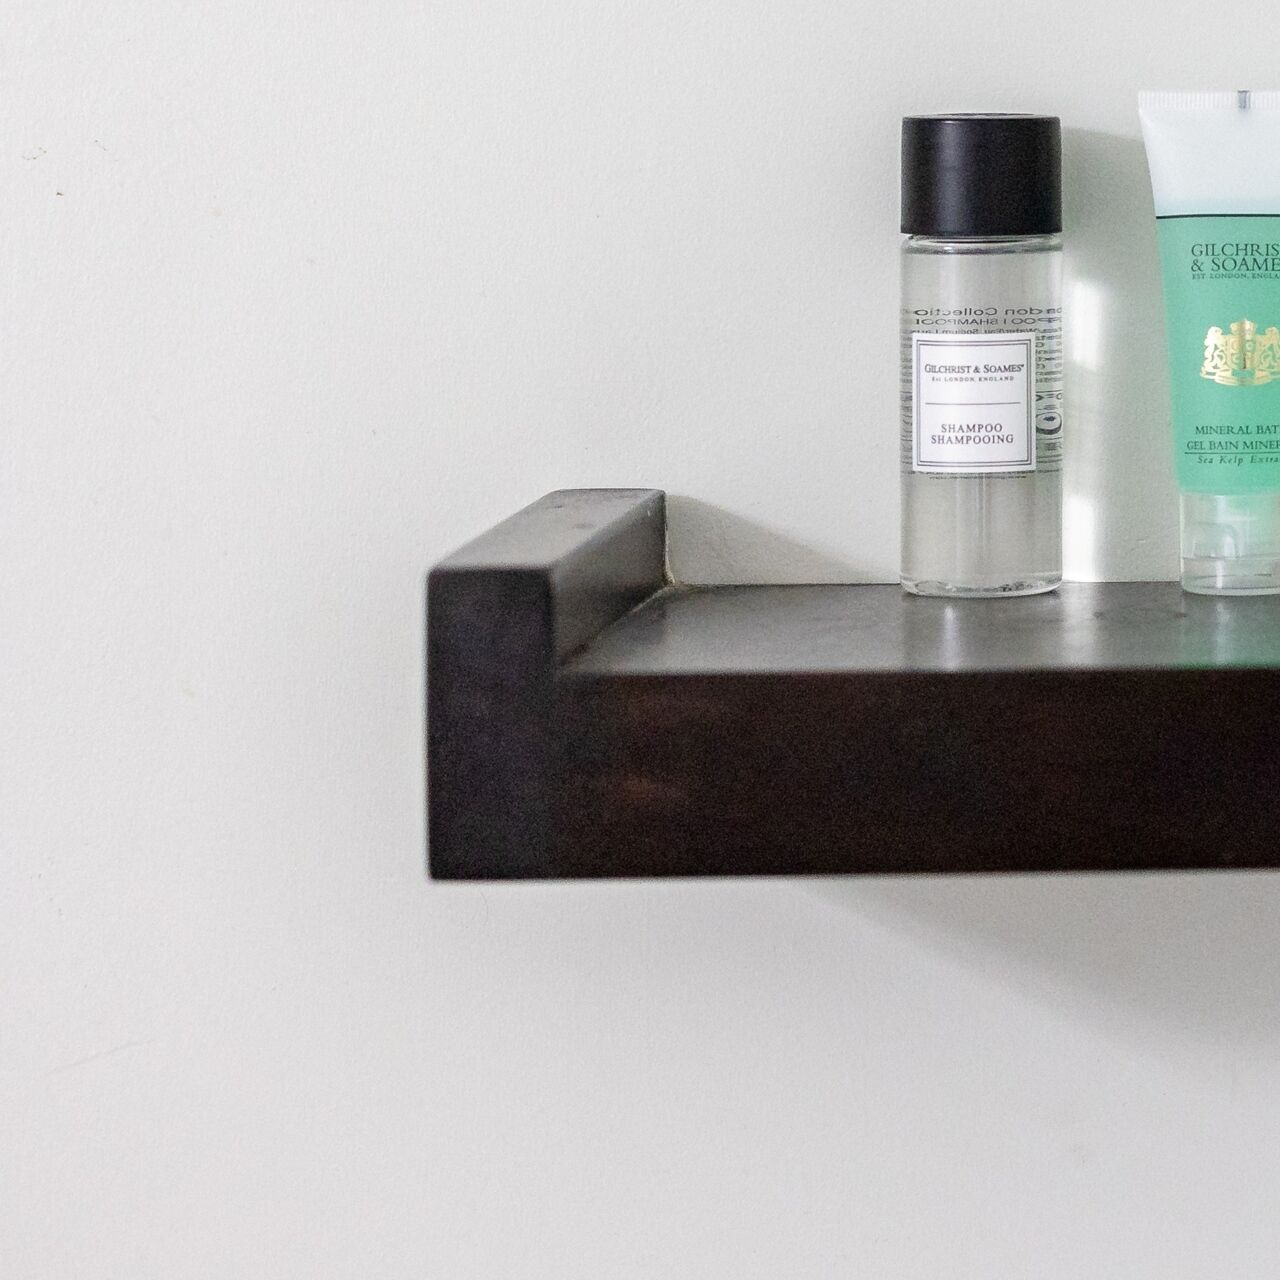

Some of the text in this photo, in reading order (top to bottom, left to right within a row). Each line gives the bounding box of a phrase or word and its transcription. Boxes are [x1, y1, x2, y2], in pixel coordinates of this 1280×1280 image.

[1190, 258, 1204, 272] &
[924, 363, 972, 374] GILCHRIST
[973, 365, 980, 373] &
[941, 423, 1003, 433] SHAMPOO
[1195, 425, 1252, 435] MINERAL
[930, 434, 1014, 445] SHAMPOOING
[1186, 440, 1206, 450] GEL
[1209, 440, 1239, 450] BAIN
[1197, 455, 1214, 464] Sea
[1219, 455, 1244, 467] Kelp
